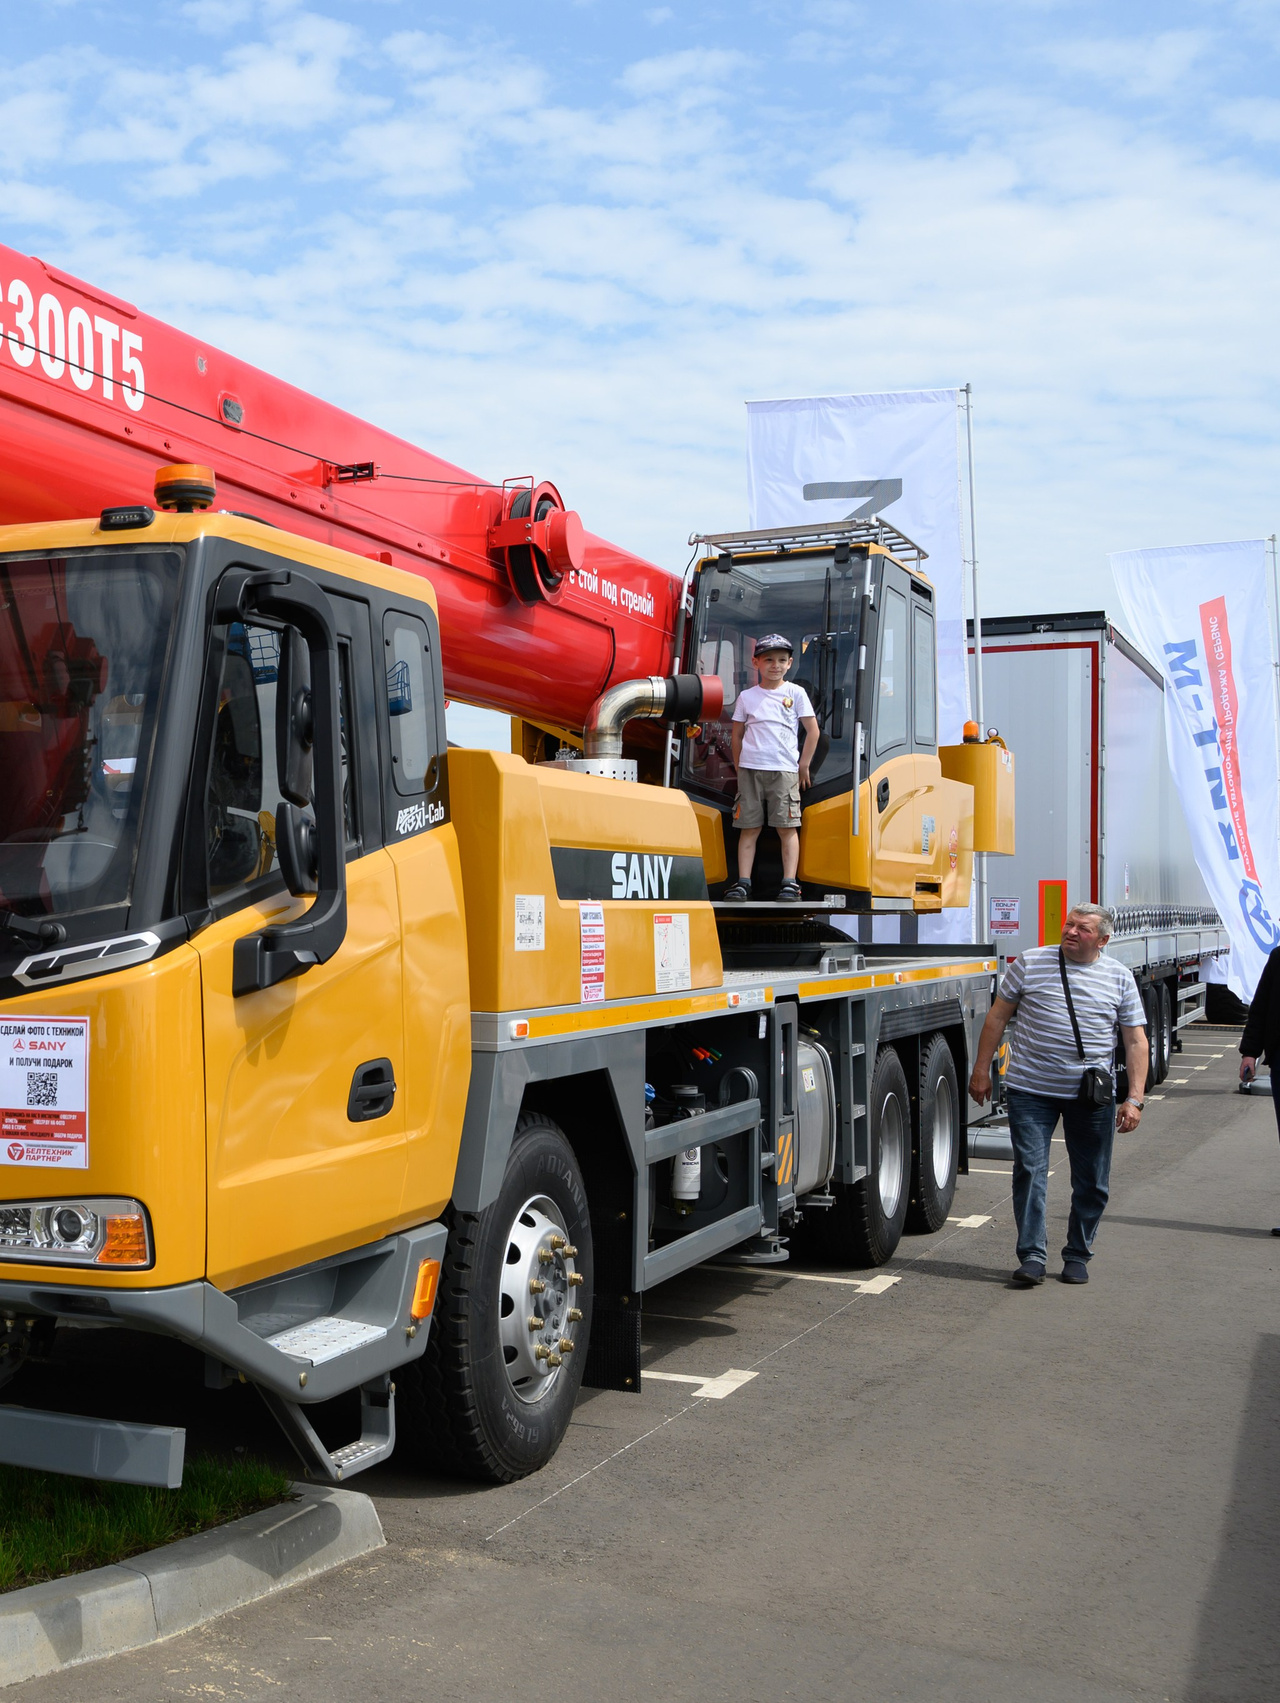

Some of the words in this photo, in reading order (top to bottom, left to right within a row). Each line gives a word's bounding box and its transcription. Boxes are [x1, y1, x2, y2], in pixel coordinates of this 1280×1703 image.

[578, 568, 598, 594] стой
[602, 579, 618, 606] под
[620, 587, 654, 618] стрелой!
[611, 852, 673, 899] SANY
[0, 1025, 26, 1036] СДЕЛАЙ
[27, 1026, 45, 1036] ФОТО
[46, 1027, 51, 1036] С
[52, 1026, 84, 1037] ТЕХНИКОЙ
[28, 1041, 67, 1051] SANY
[9, 1057, 14, 1066] И
[15, 1057, 42, 1067] ПОЛУЧИ
[43, 1058, 73, 1069] ПОДАРОК
[25, 1148, 73, 1156] БЕЛТЕХНИК
[25, 1154, 62, 1162] ПАРТНЕР
